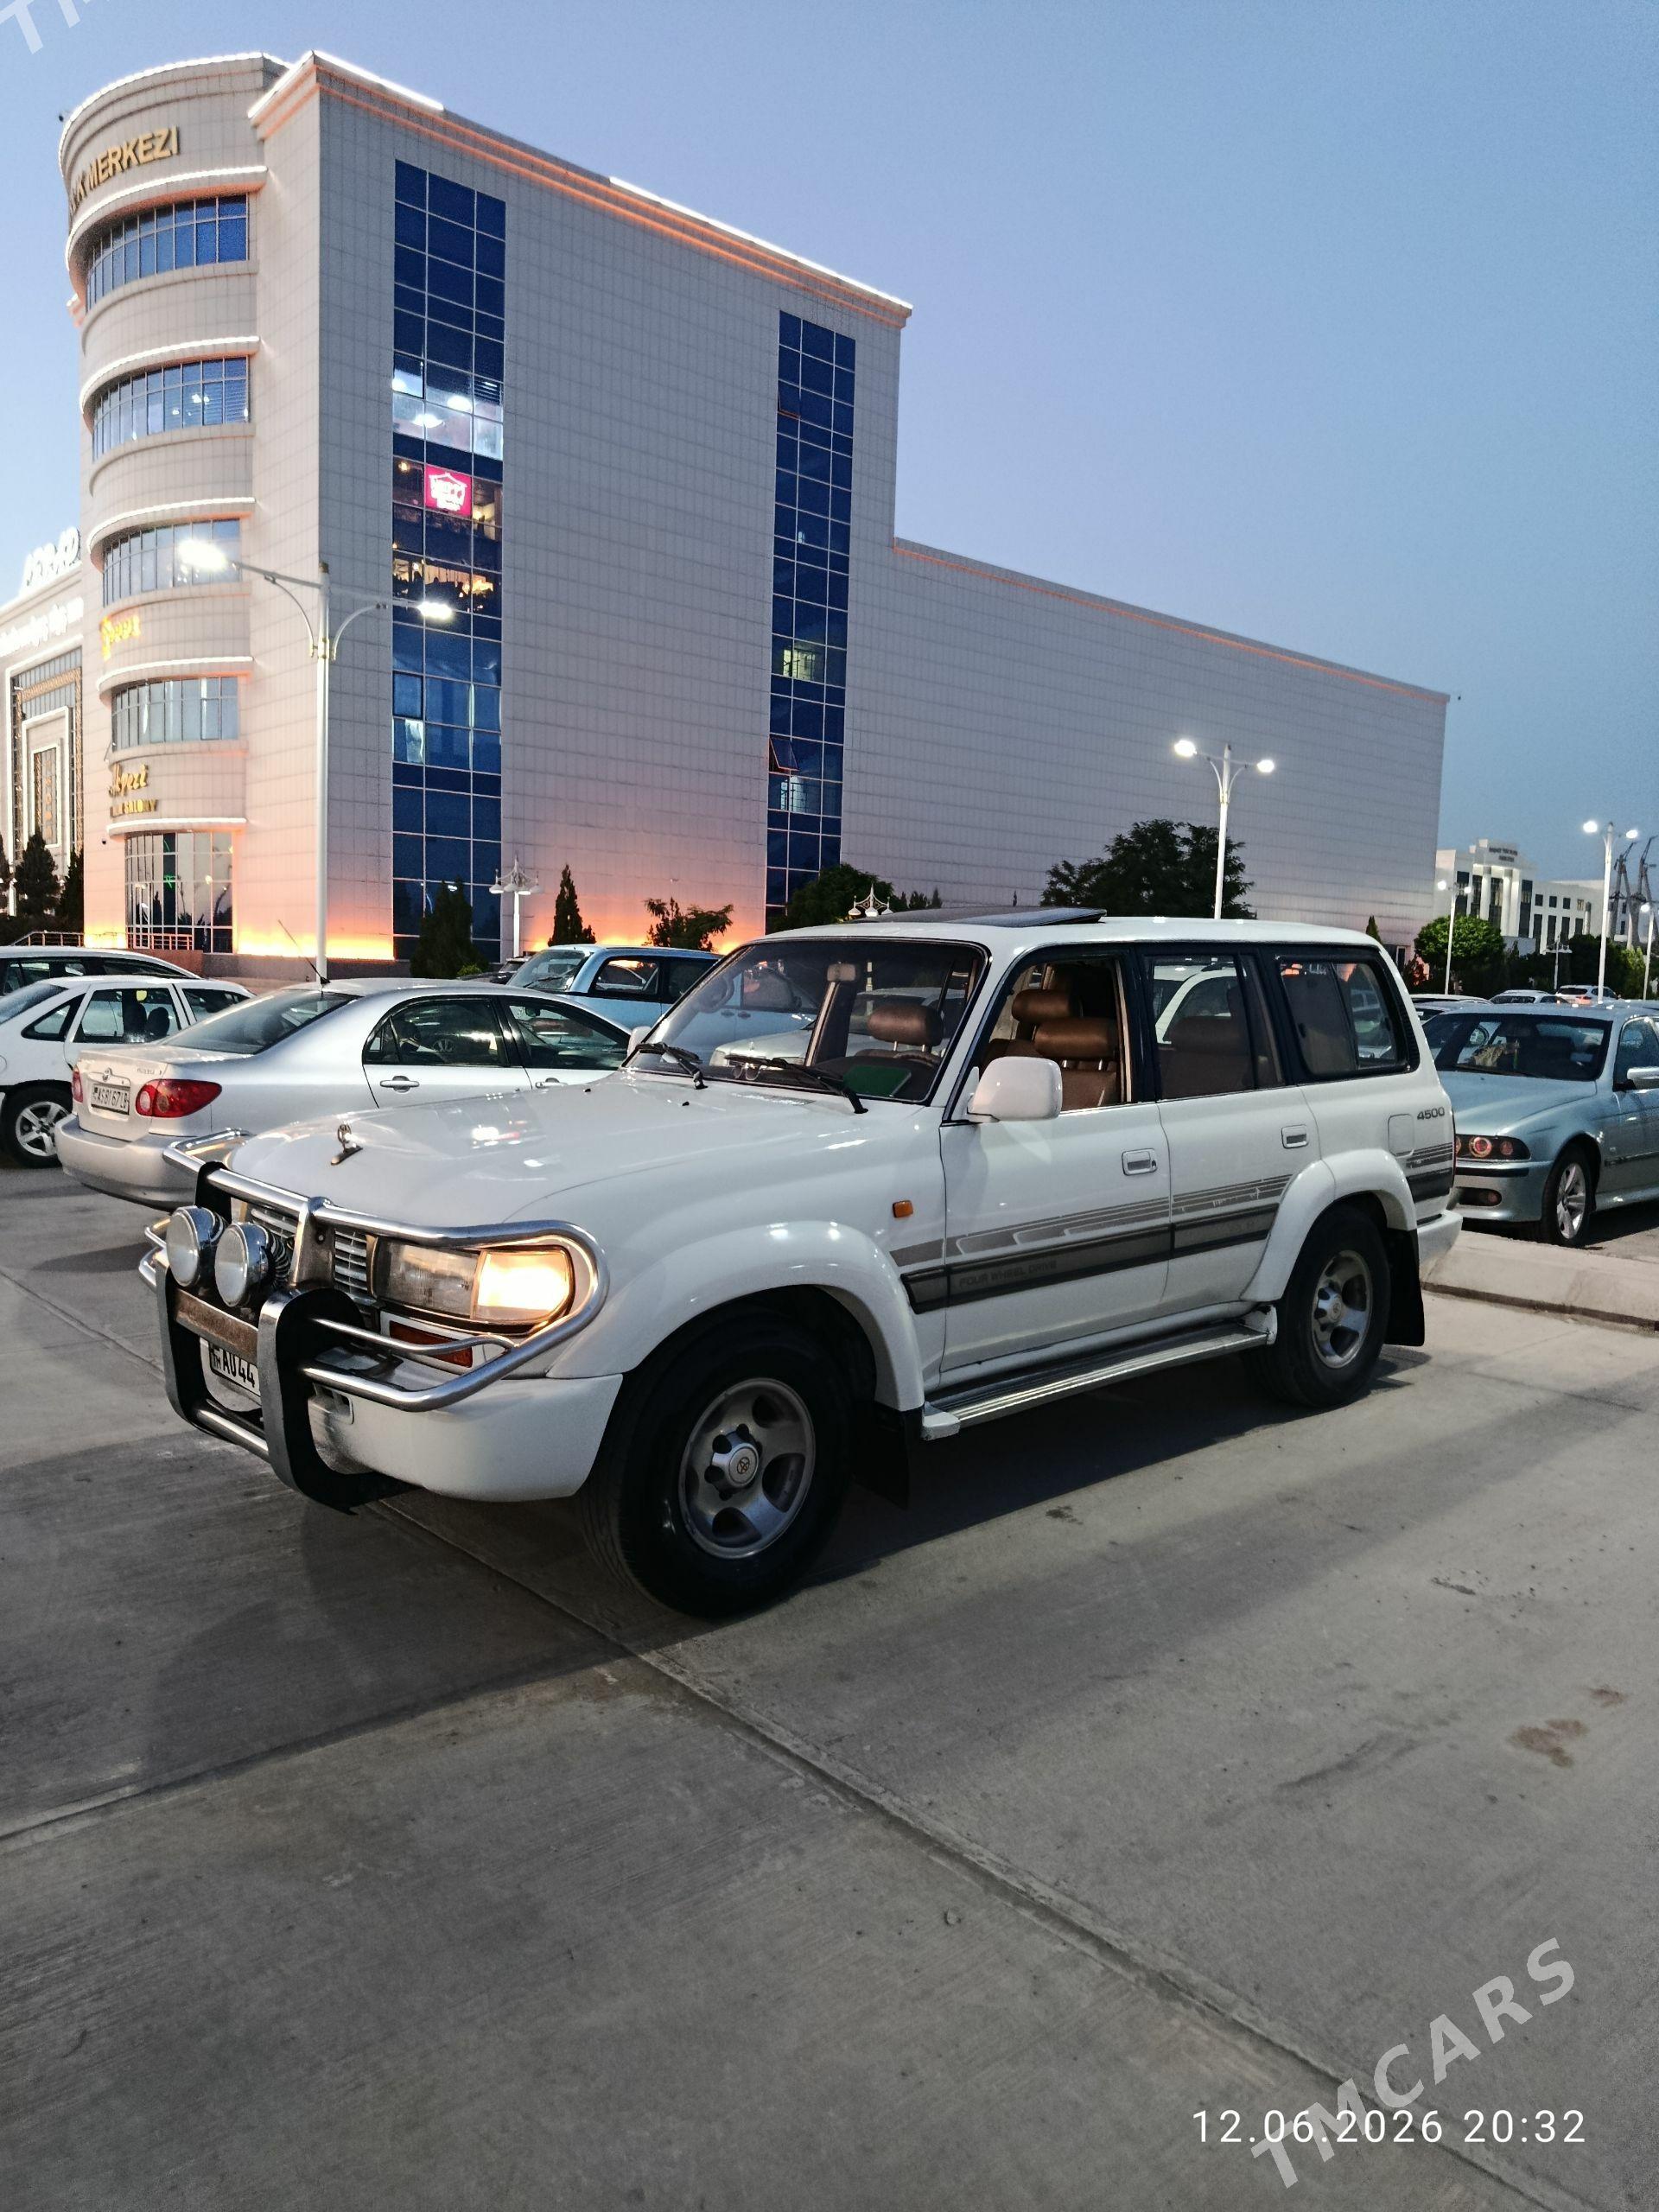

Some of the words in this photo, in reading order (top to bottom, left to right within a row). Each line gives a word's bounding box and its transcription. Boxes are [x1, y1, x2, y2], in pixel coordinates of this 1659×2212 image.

[87, 125, 178, 190] MERKEZI
[1417, 1107, 1445, 1120] 4500
[959, 1273, 988, 1287] FOUR
[990, 1267, 1026, 1281] WHEEL
[1028, 1260, 1057, 1273] DRIVE
